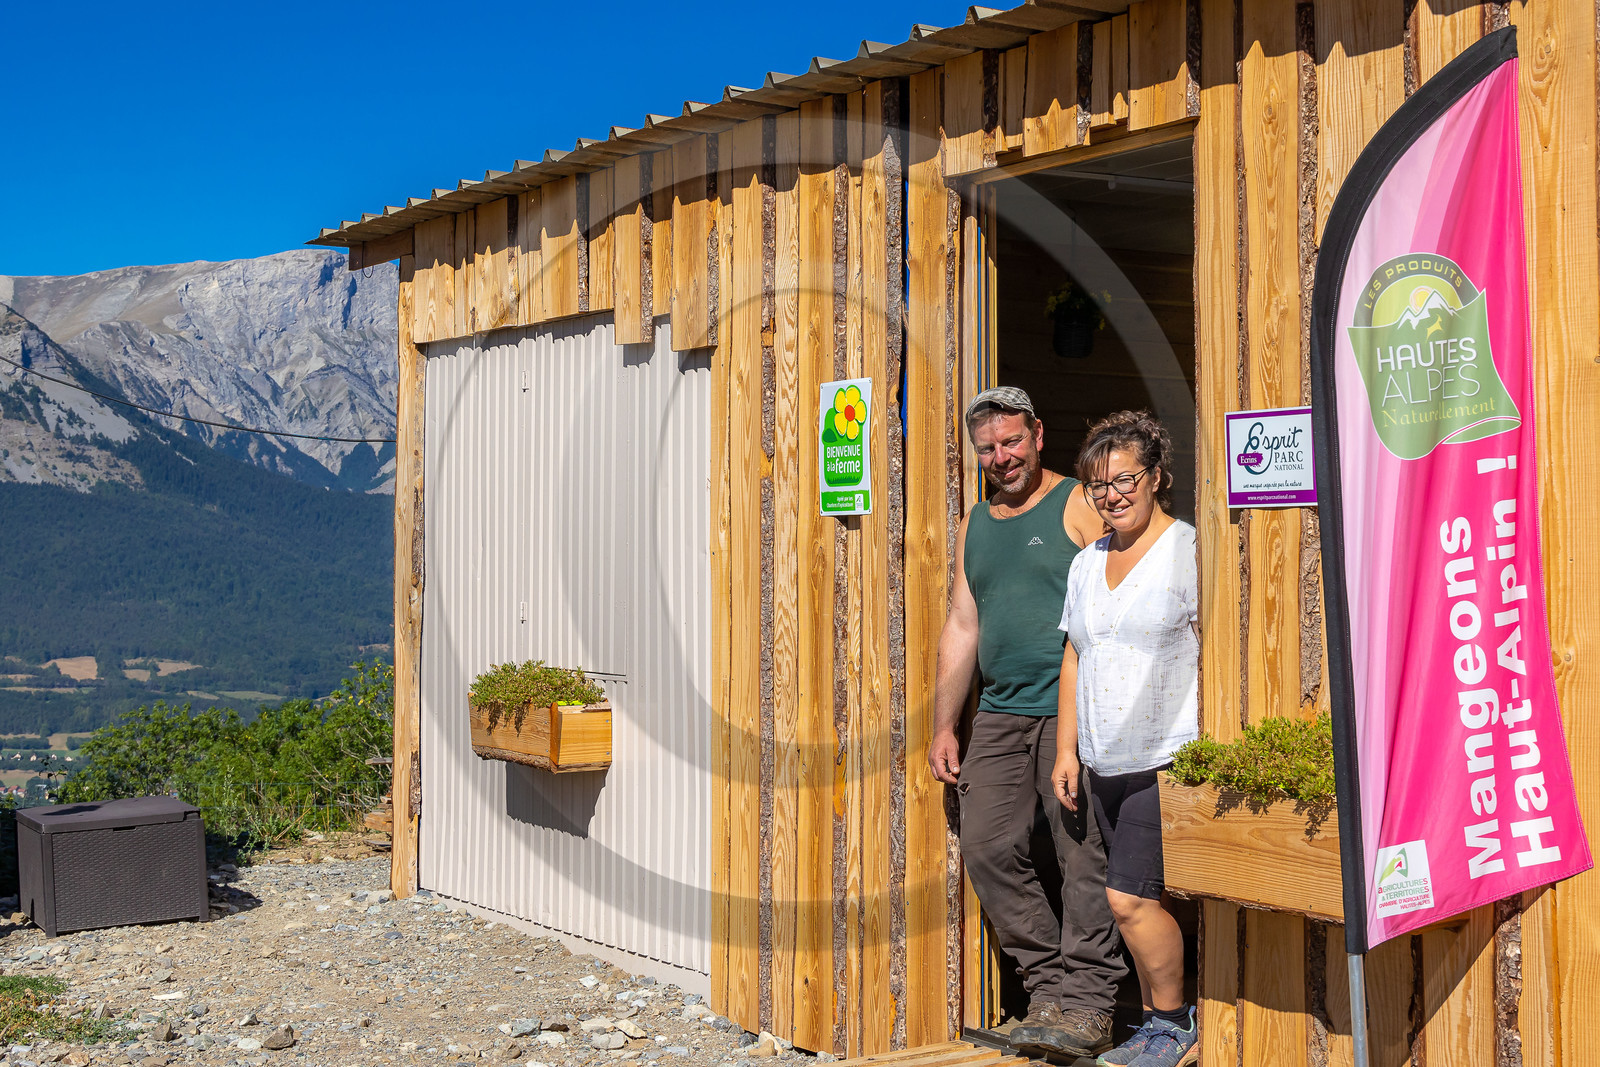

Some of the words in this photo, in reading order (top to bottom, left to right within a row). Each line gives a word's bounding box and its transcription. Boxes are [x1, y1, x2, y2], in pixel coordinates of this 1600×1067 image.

[1364, 279, 1382, 310] LES
[1385, 260, 1463, 288] PRODUITS
[1376, 337, 1477, 373] HAUTES
[1382, 363, 1481, 407] ALPES
[1381, 397, 1496, 428] Naturellement
[826, 444, 861, 458] BIENVENUE
[1243, 422, 1303, 475] Esprit
[1274, 450, 1304, 464] PARC
[827, 461, 830, 472] à
[830, 461, 835, 472] la
[835, 458, 861, 474] ferme
[1274, 463, 1305, 471] NATIONAL
[1477, 454, 1517, 475] !
[1486, 497, 1562, 868] Haut-Alpin
[1439, 515, 1506, 880] Mangeons
[1386, 886, 1430, 900] TERRITOIRES
[1399, 894, 1430, 904] D'AGRICULTURE
